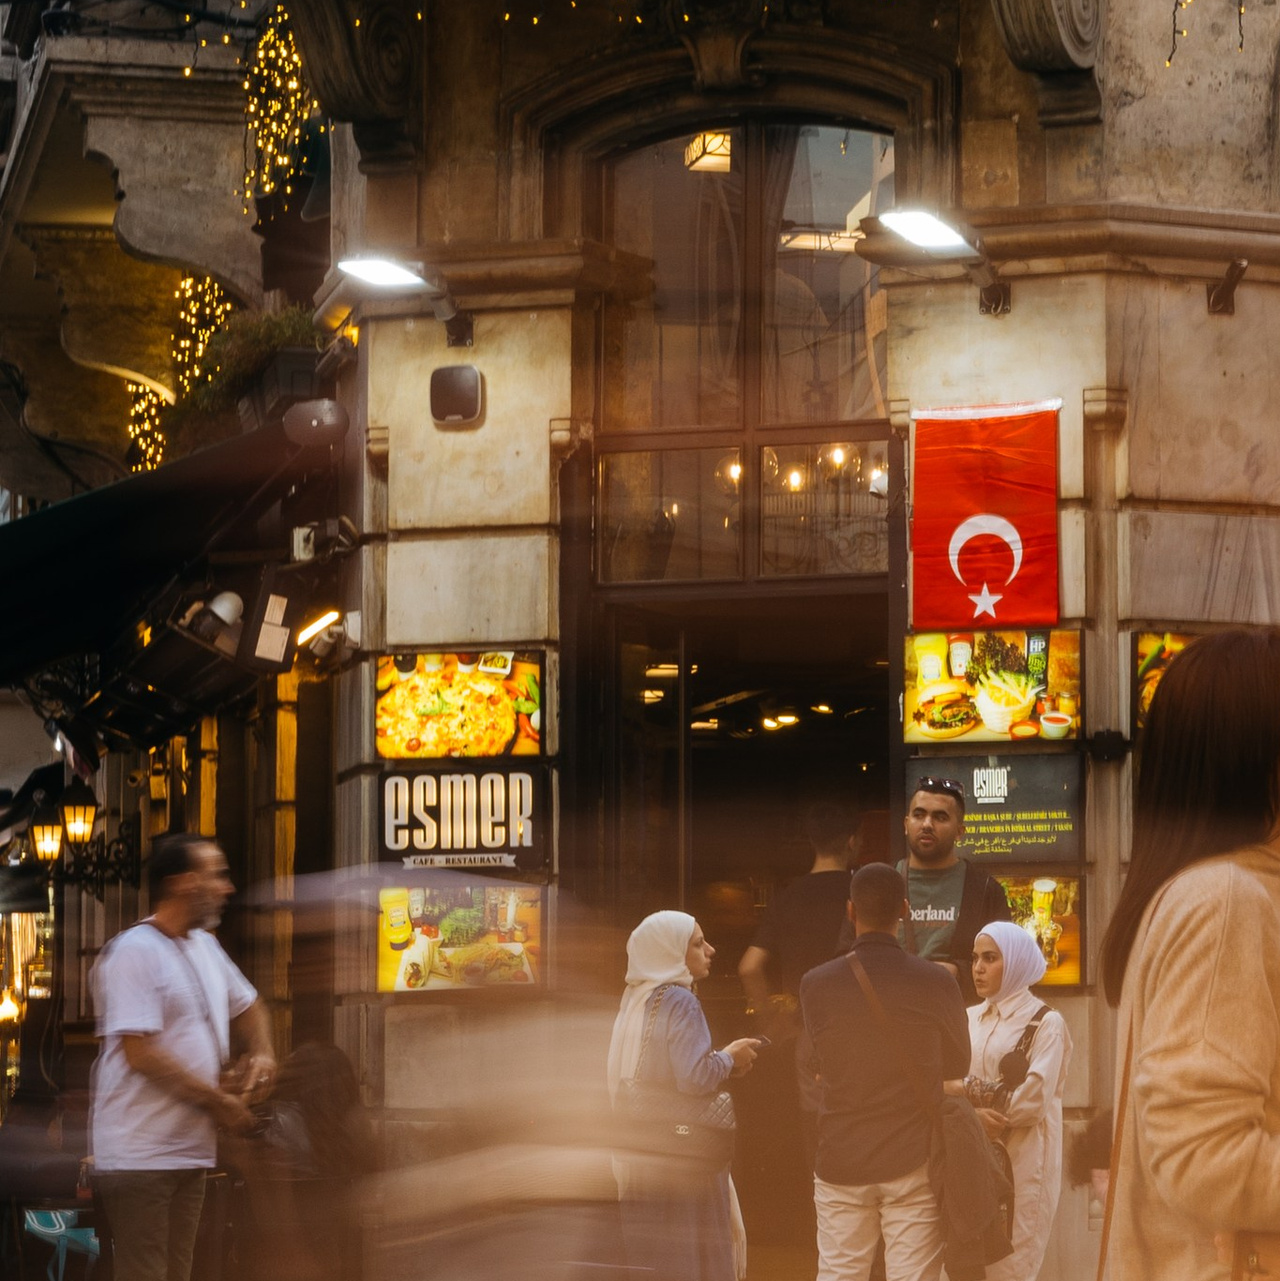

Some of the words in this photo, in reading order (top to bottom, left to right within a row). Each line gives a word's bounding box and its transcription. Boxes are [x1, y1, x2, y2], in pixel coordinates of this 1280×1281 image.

[1030, 638, 1046, 653] HP
[413, 858, 435, 866] CAFE
[445, 856, 504, 865] RESTAURANT
